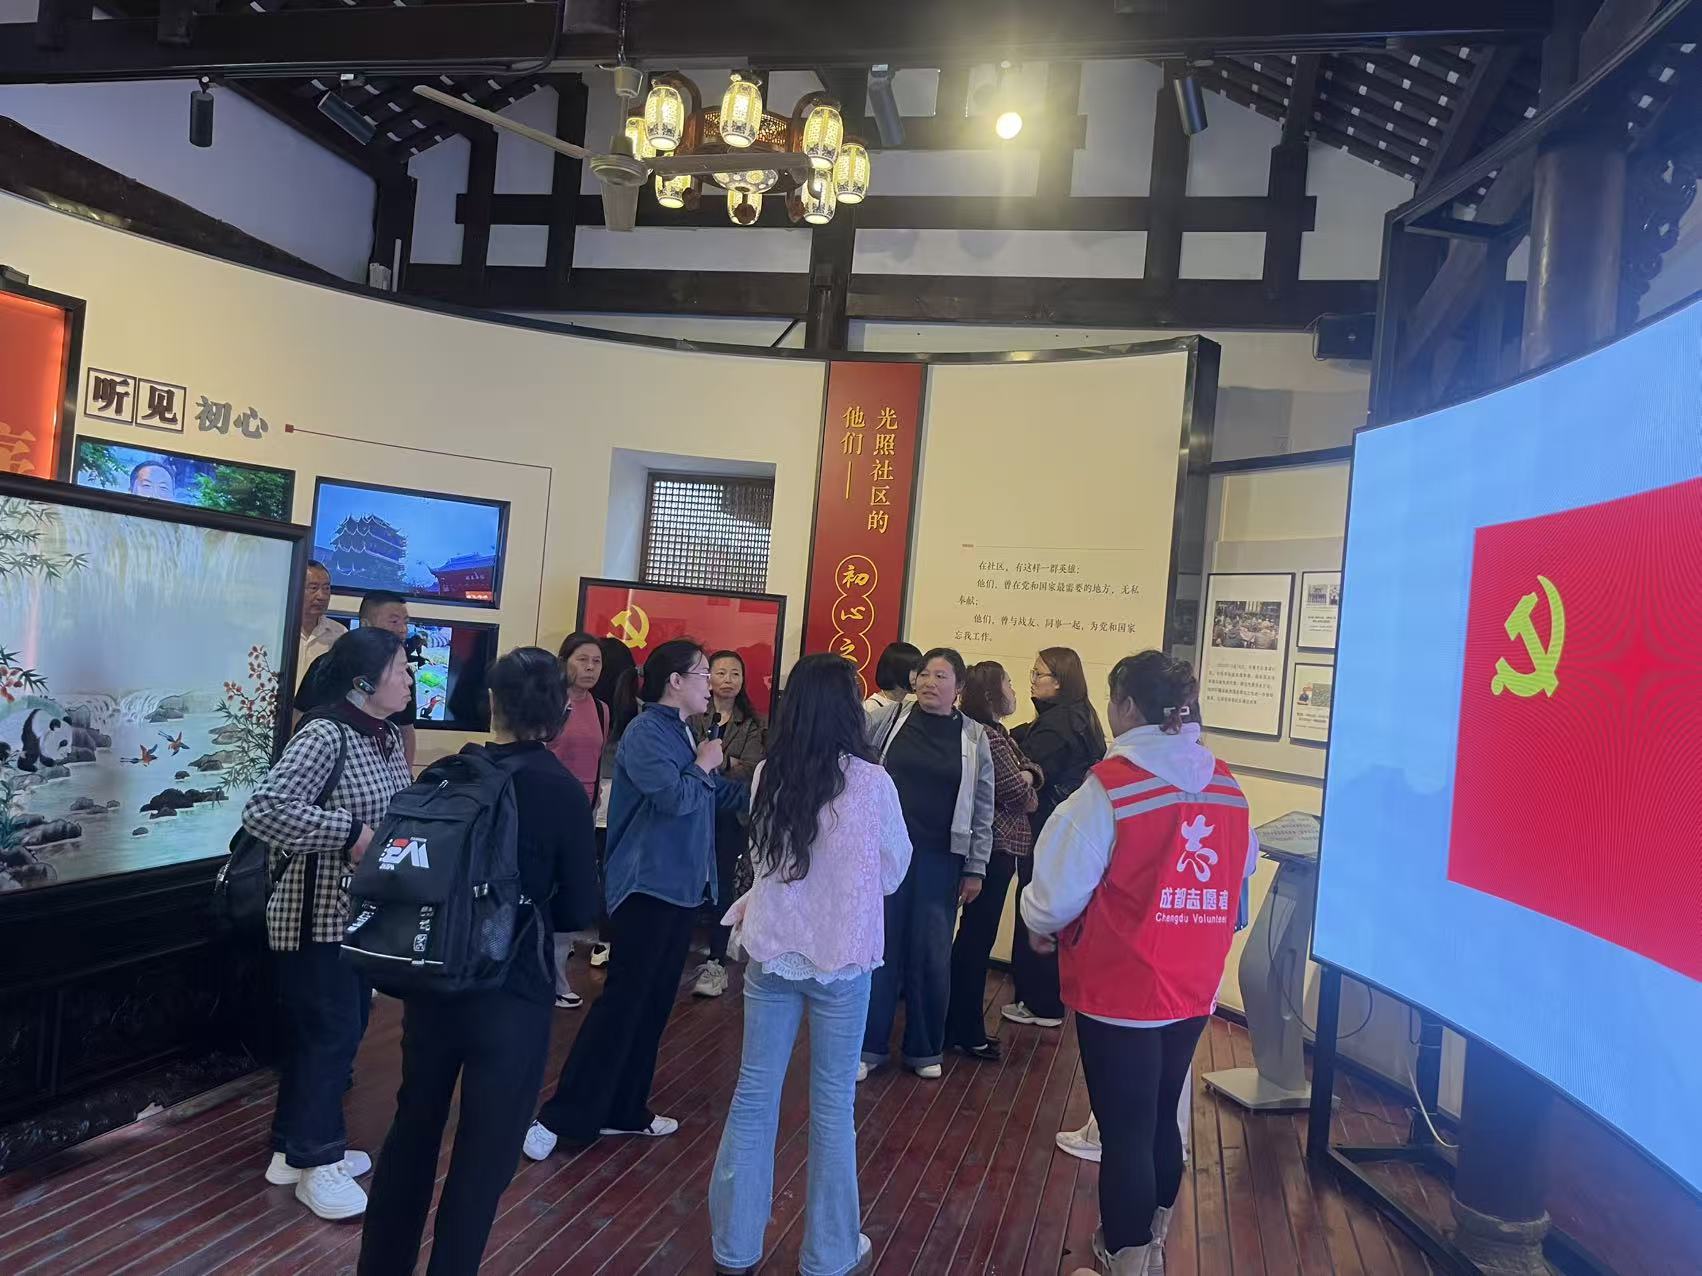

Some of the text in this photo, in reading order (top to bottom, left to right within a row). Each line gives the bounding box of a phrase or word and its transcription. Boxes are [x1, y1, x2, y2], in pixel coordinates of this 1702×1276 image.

[867, 406, 899, 534] 光照社区的
[1160, 887, 1229, 910] 成都志愿者
[1155, 912, 1189, 925] Chengdu
